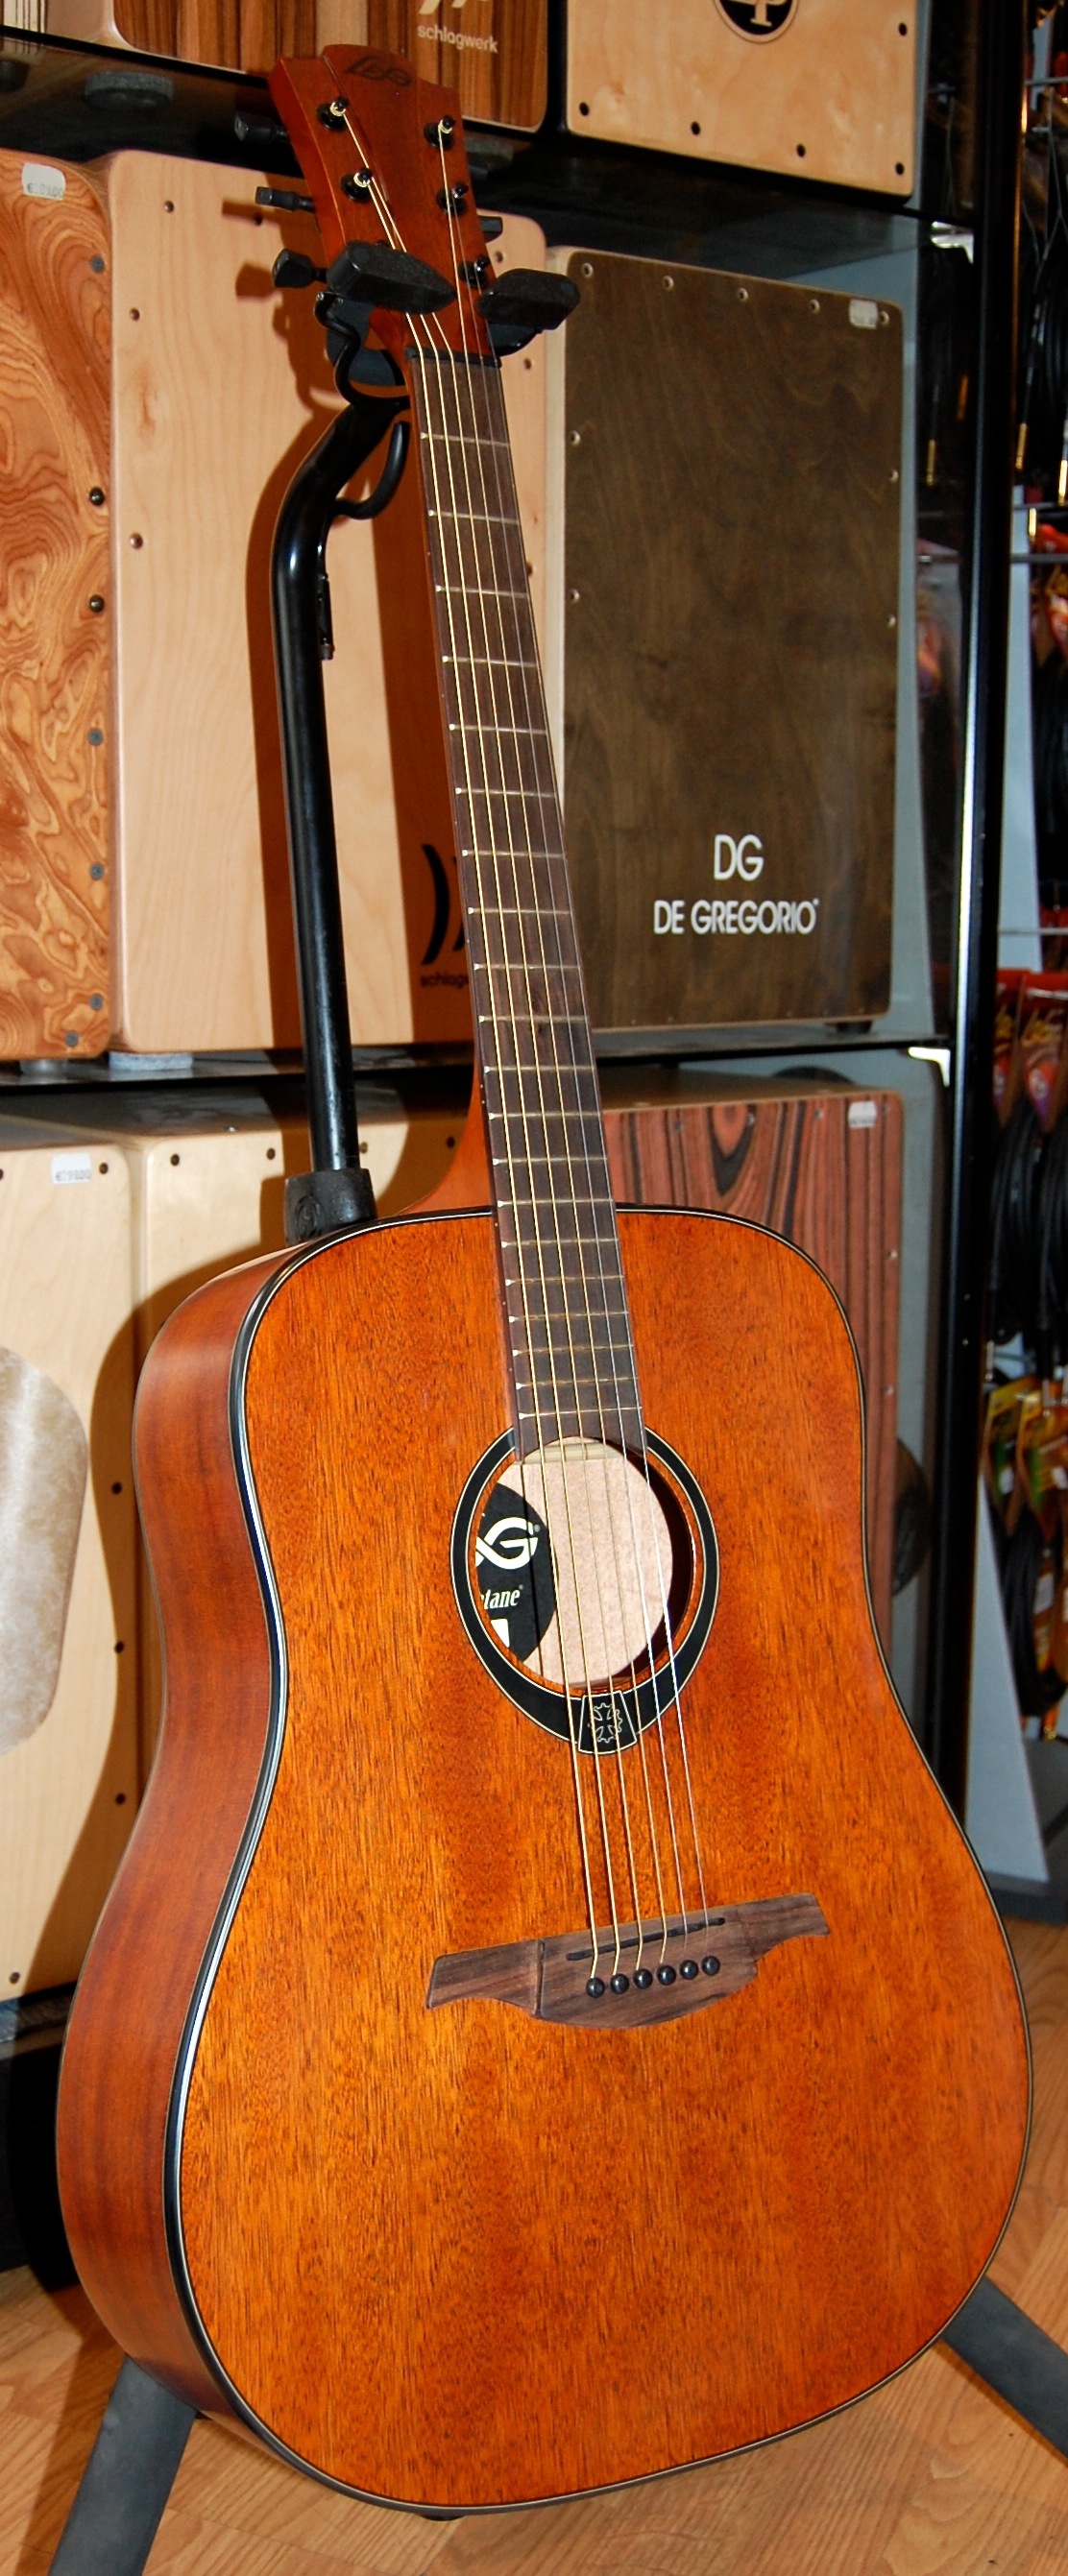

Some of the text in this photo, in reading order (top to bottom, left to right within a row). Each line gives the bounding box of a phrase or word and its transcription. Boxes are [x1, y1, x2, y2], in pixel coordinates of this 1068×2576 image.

[417, 24, 498, 54] schlagwerk
[714, 834, 765, 881] DG
[654, 899, 816, 934] DE GREGORIO
[420, 971, 469, 989] schlag
[480, 1588, 521, 1610] tane
